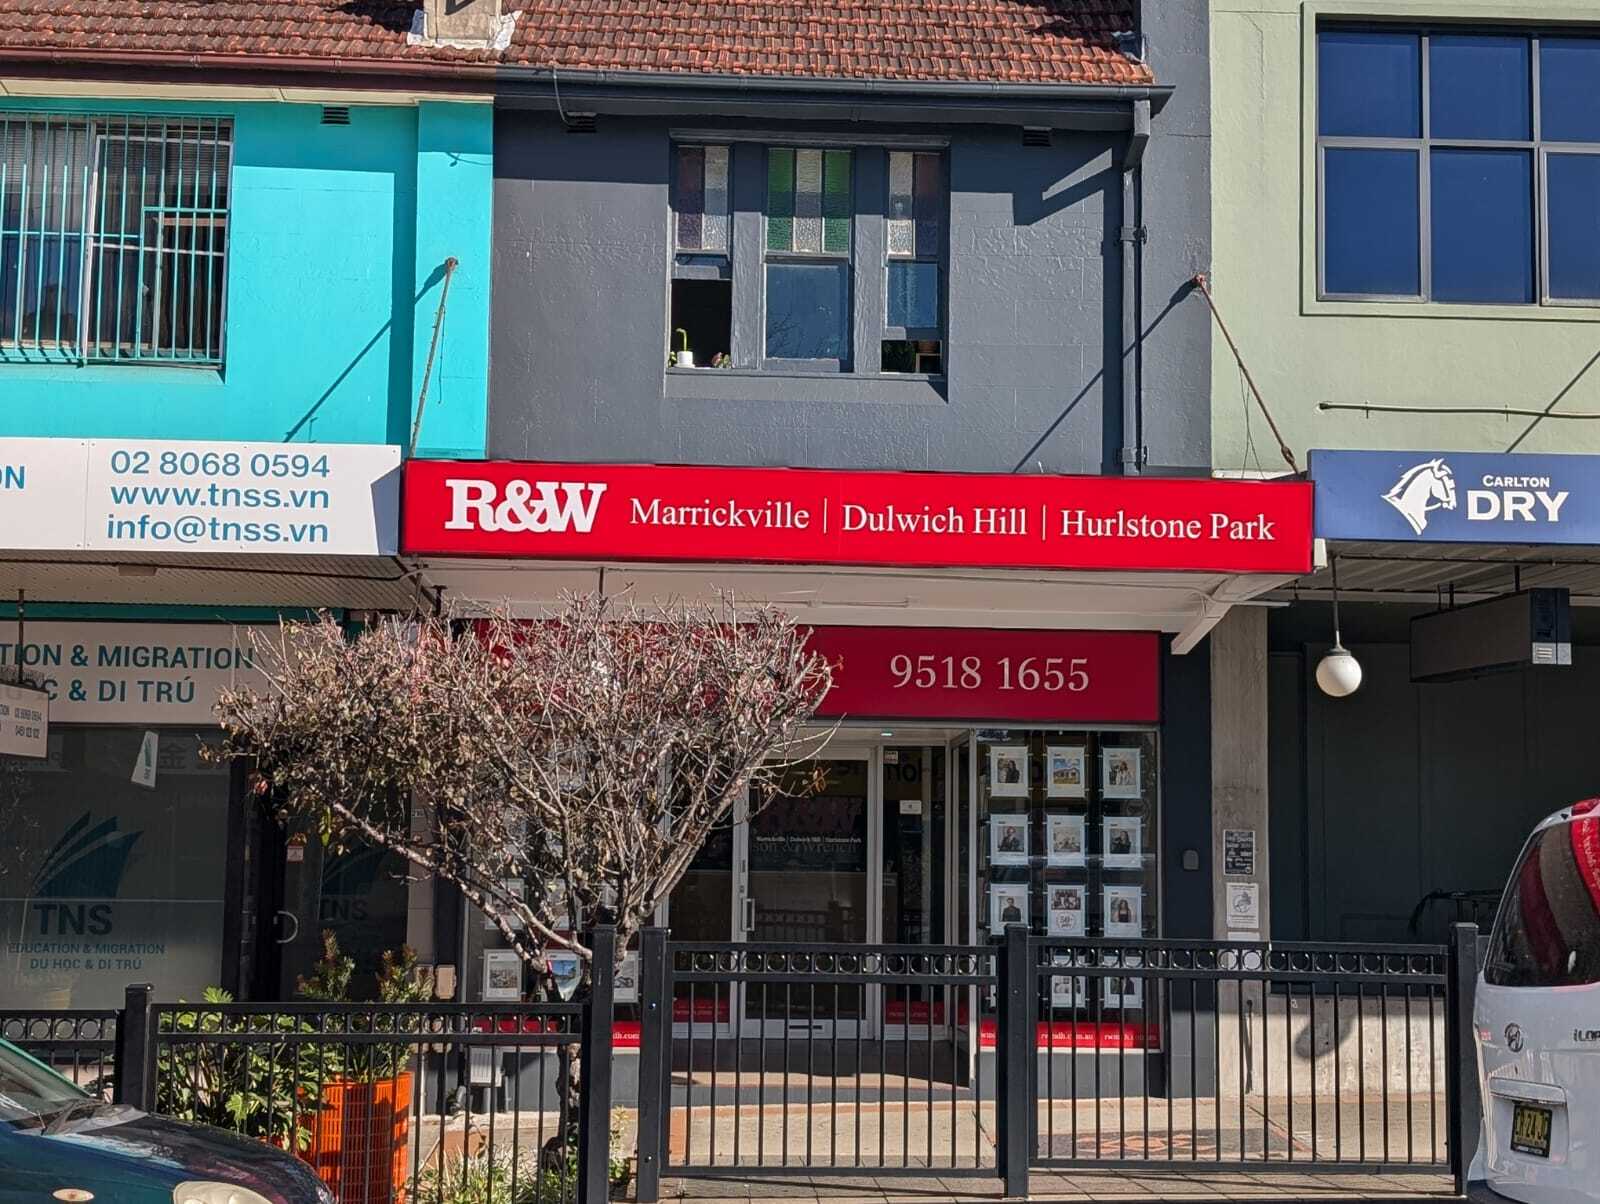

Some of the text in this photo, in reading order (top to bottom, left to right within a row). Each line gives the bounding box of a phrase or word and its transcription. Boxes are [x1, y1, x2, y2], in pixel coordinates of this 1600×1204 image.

[0, 465, 25, 490] N
[110, 450, 330, 478] 02 8068 0594
[111, 483, 330, 509] www.tnss.vn
[444, 478, 607, 534] R&W
[1467, 490, 1569, 522] DRY
[107, 514, 328, 544] info@tnss.vn
[629, 497, 1276, 541] Marrickville Dulwich Hill Hurlstone Park
[70, 644, 89, 667] &
[97, 645, 254, 670] MIGRATION
[890, 654, 1090, 691] 9518 1655
[68, 679, 87, 701] &
[99, 680, 127, 703] DI
[138, 676, 195, 703] TRÚ
[33, 903, 113, 936] TNS
[8, 943, 165, 955] EDUCATION & MIGRATION
[30, 958, 49, 970] DU
[85, 959, 95, 970] &
[98, 960, 111, 970] DI
